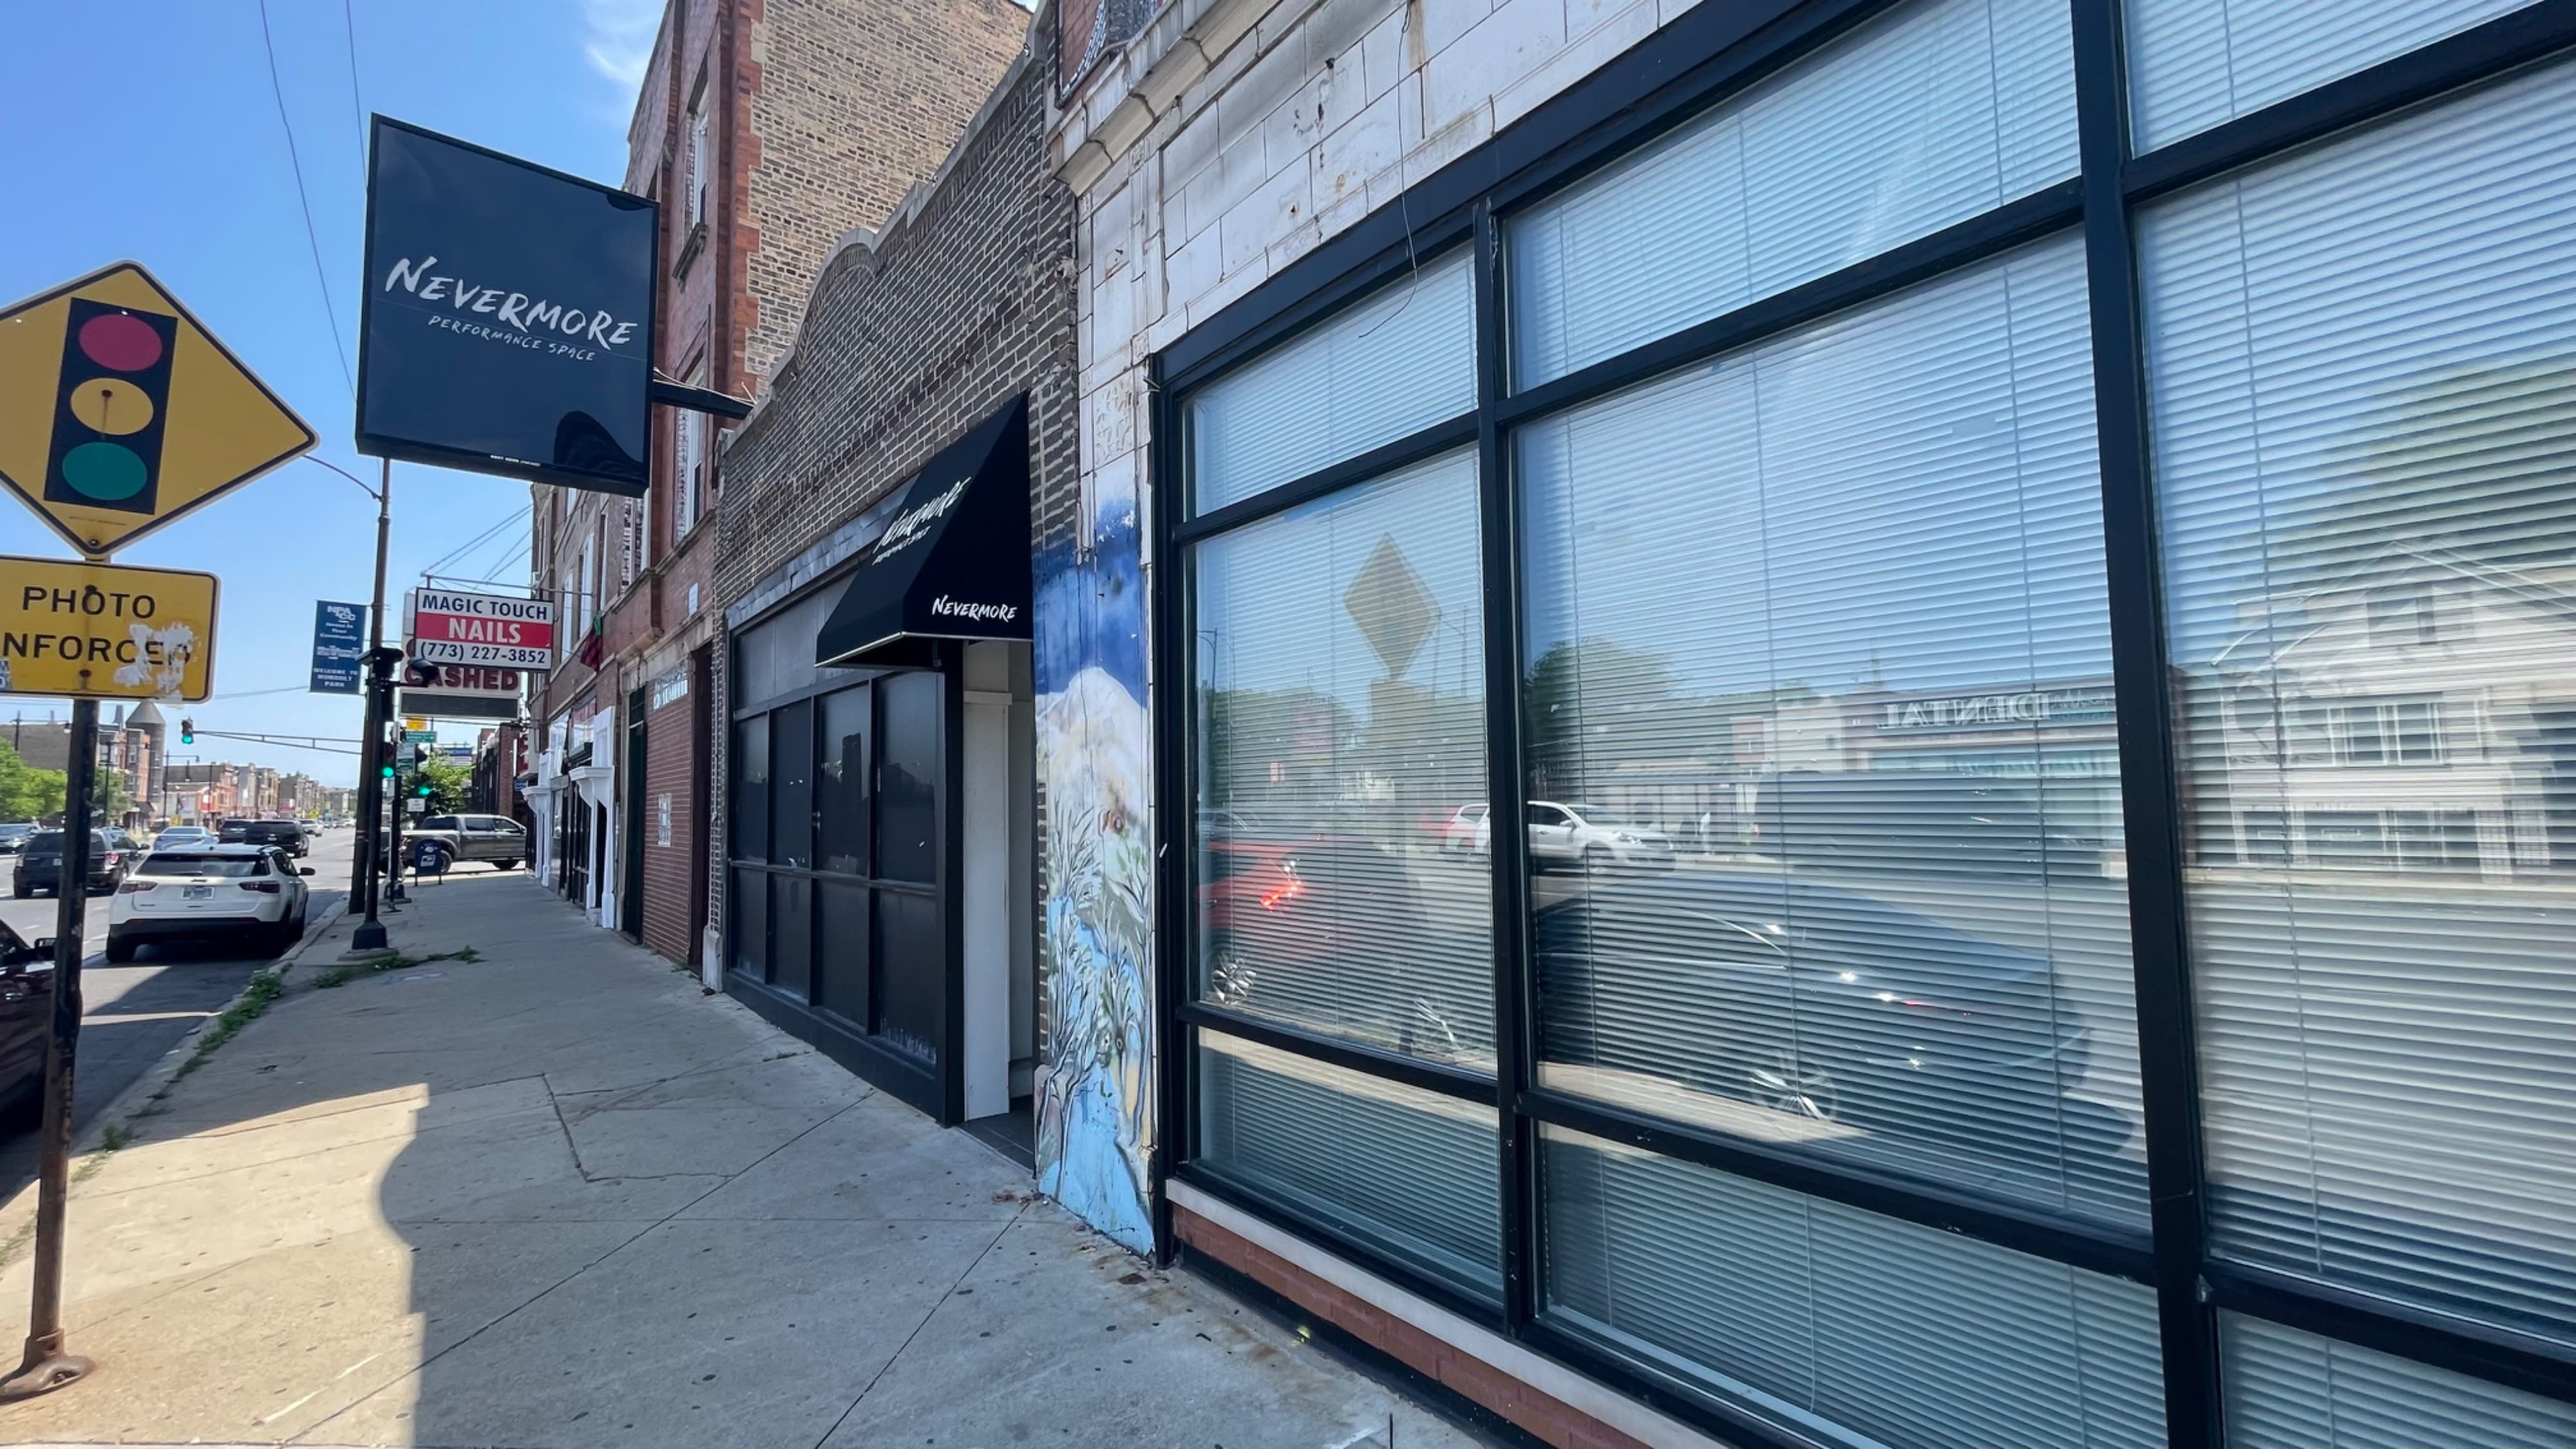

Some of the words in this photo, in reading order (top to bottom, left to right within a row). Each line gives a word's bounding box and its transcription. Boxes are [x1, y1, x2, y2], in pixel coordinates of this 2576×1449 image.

[385, 256, 638, 350] NEVERMORE
[428, 315, 542, 349] PERFORMANCE
[548, 343, 596, 361] SPACE
[23, 585, 156, 620] PHOTO
[422, 594, 483, 614] MAGIC
[489, 601, 547, 620] TOUCH
[932, 594, 1018, 623] NEVERMORE
[448, 618, 521, 644] NAILS
[421, 641, 464, 661] (773)
[471, 646, 545, 664] 227-3852
